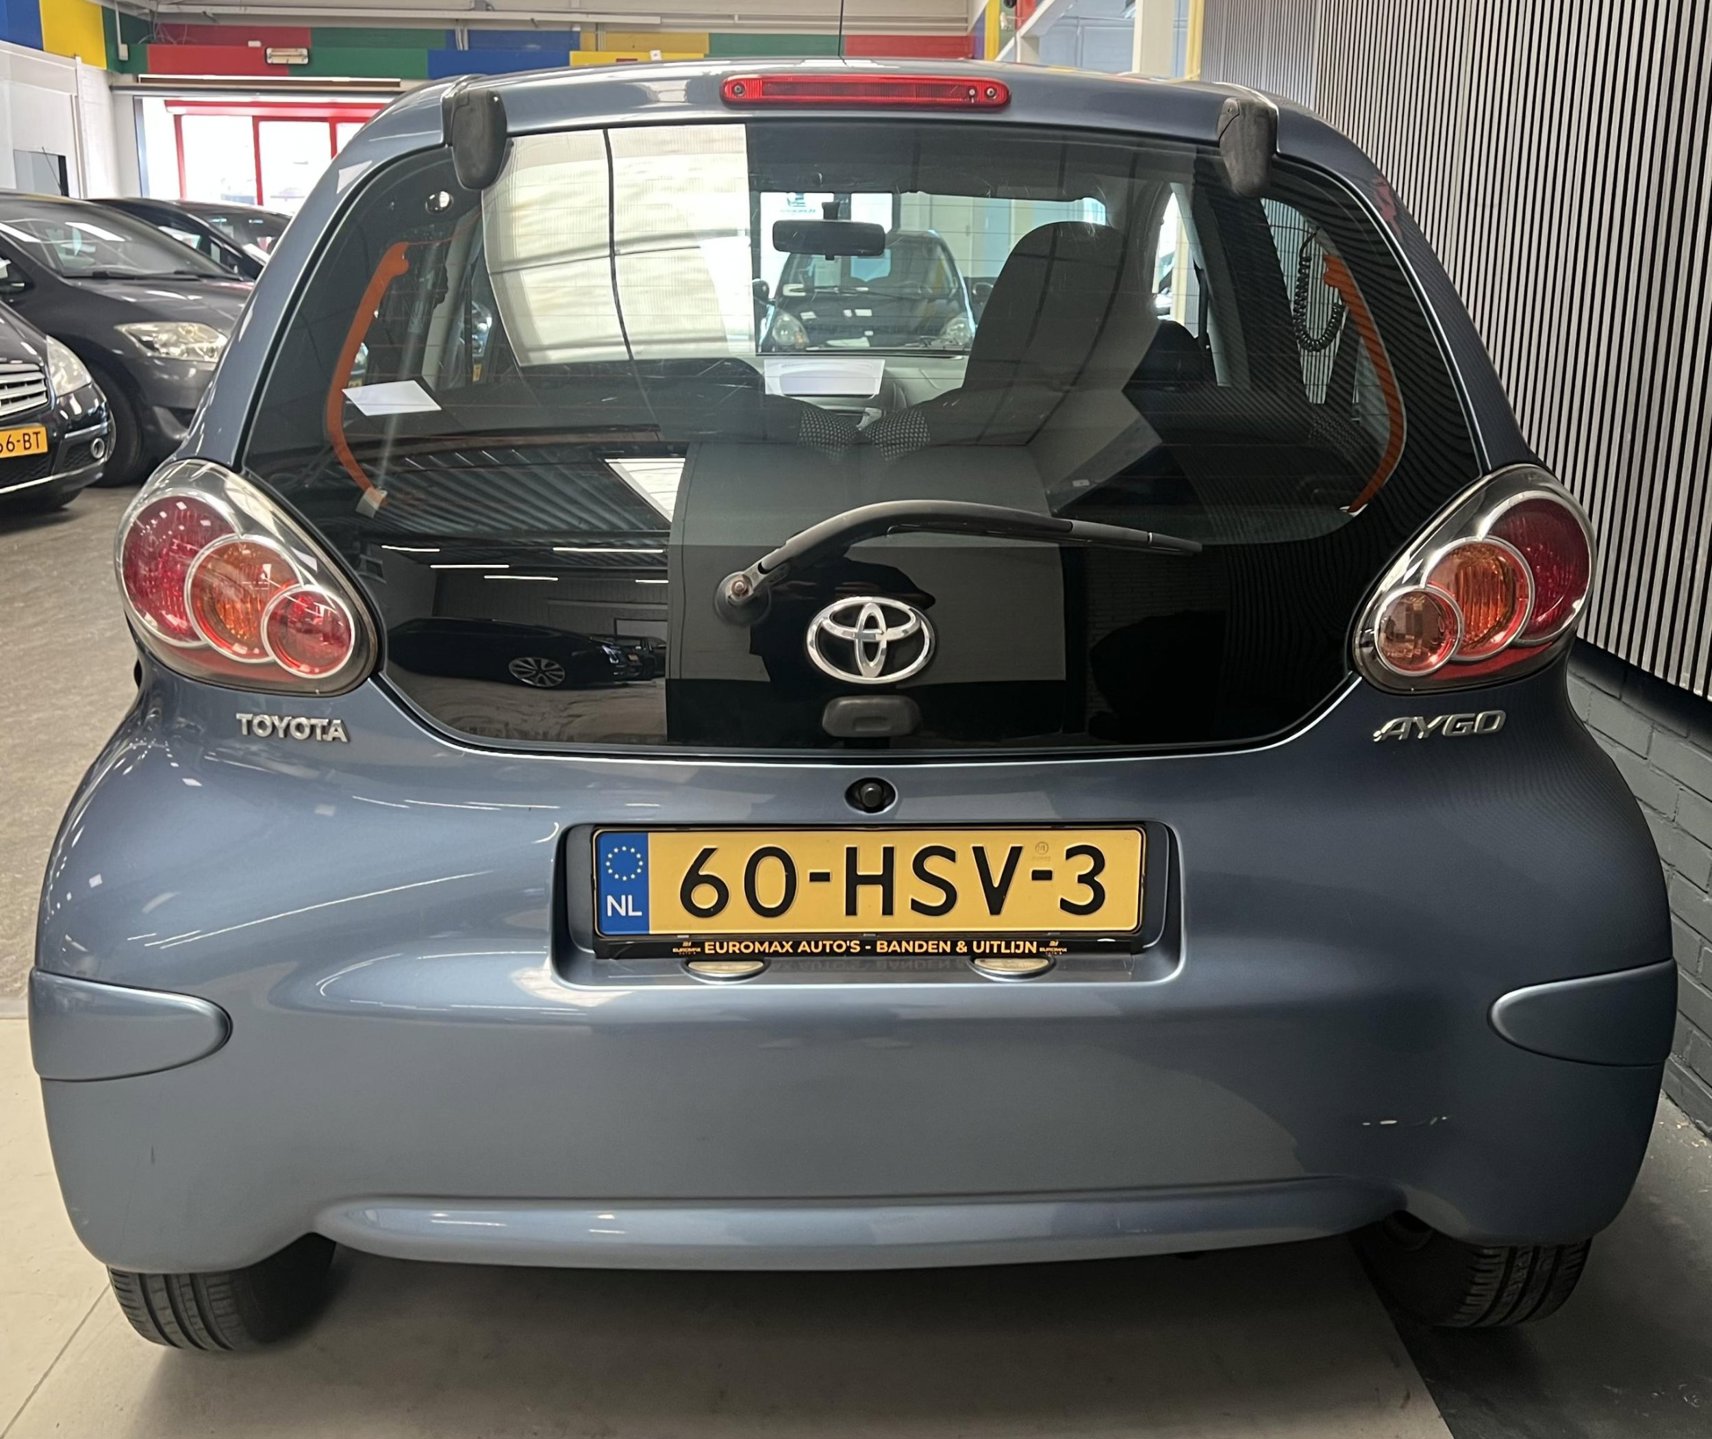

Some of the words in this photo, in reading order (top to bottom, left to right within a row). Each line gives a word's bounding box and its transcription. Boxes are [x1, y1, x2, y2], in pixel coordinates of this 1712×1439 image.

[236, 713, 348, 742] TOYOTA
[1373, 710, 1506, 742] AYGO
[680, 844, 1107, 919] 60-HSV-3
[606, 895, 642, 917] NL
[704, 940, 793, 954] EUROMAX
[797, 940, 861, 953] AUTO'S
[876, 940, 951, 953] BANDEN
[956, 940, 968, 953] &
[972, 940, 1037, 954] UITLIJN
